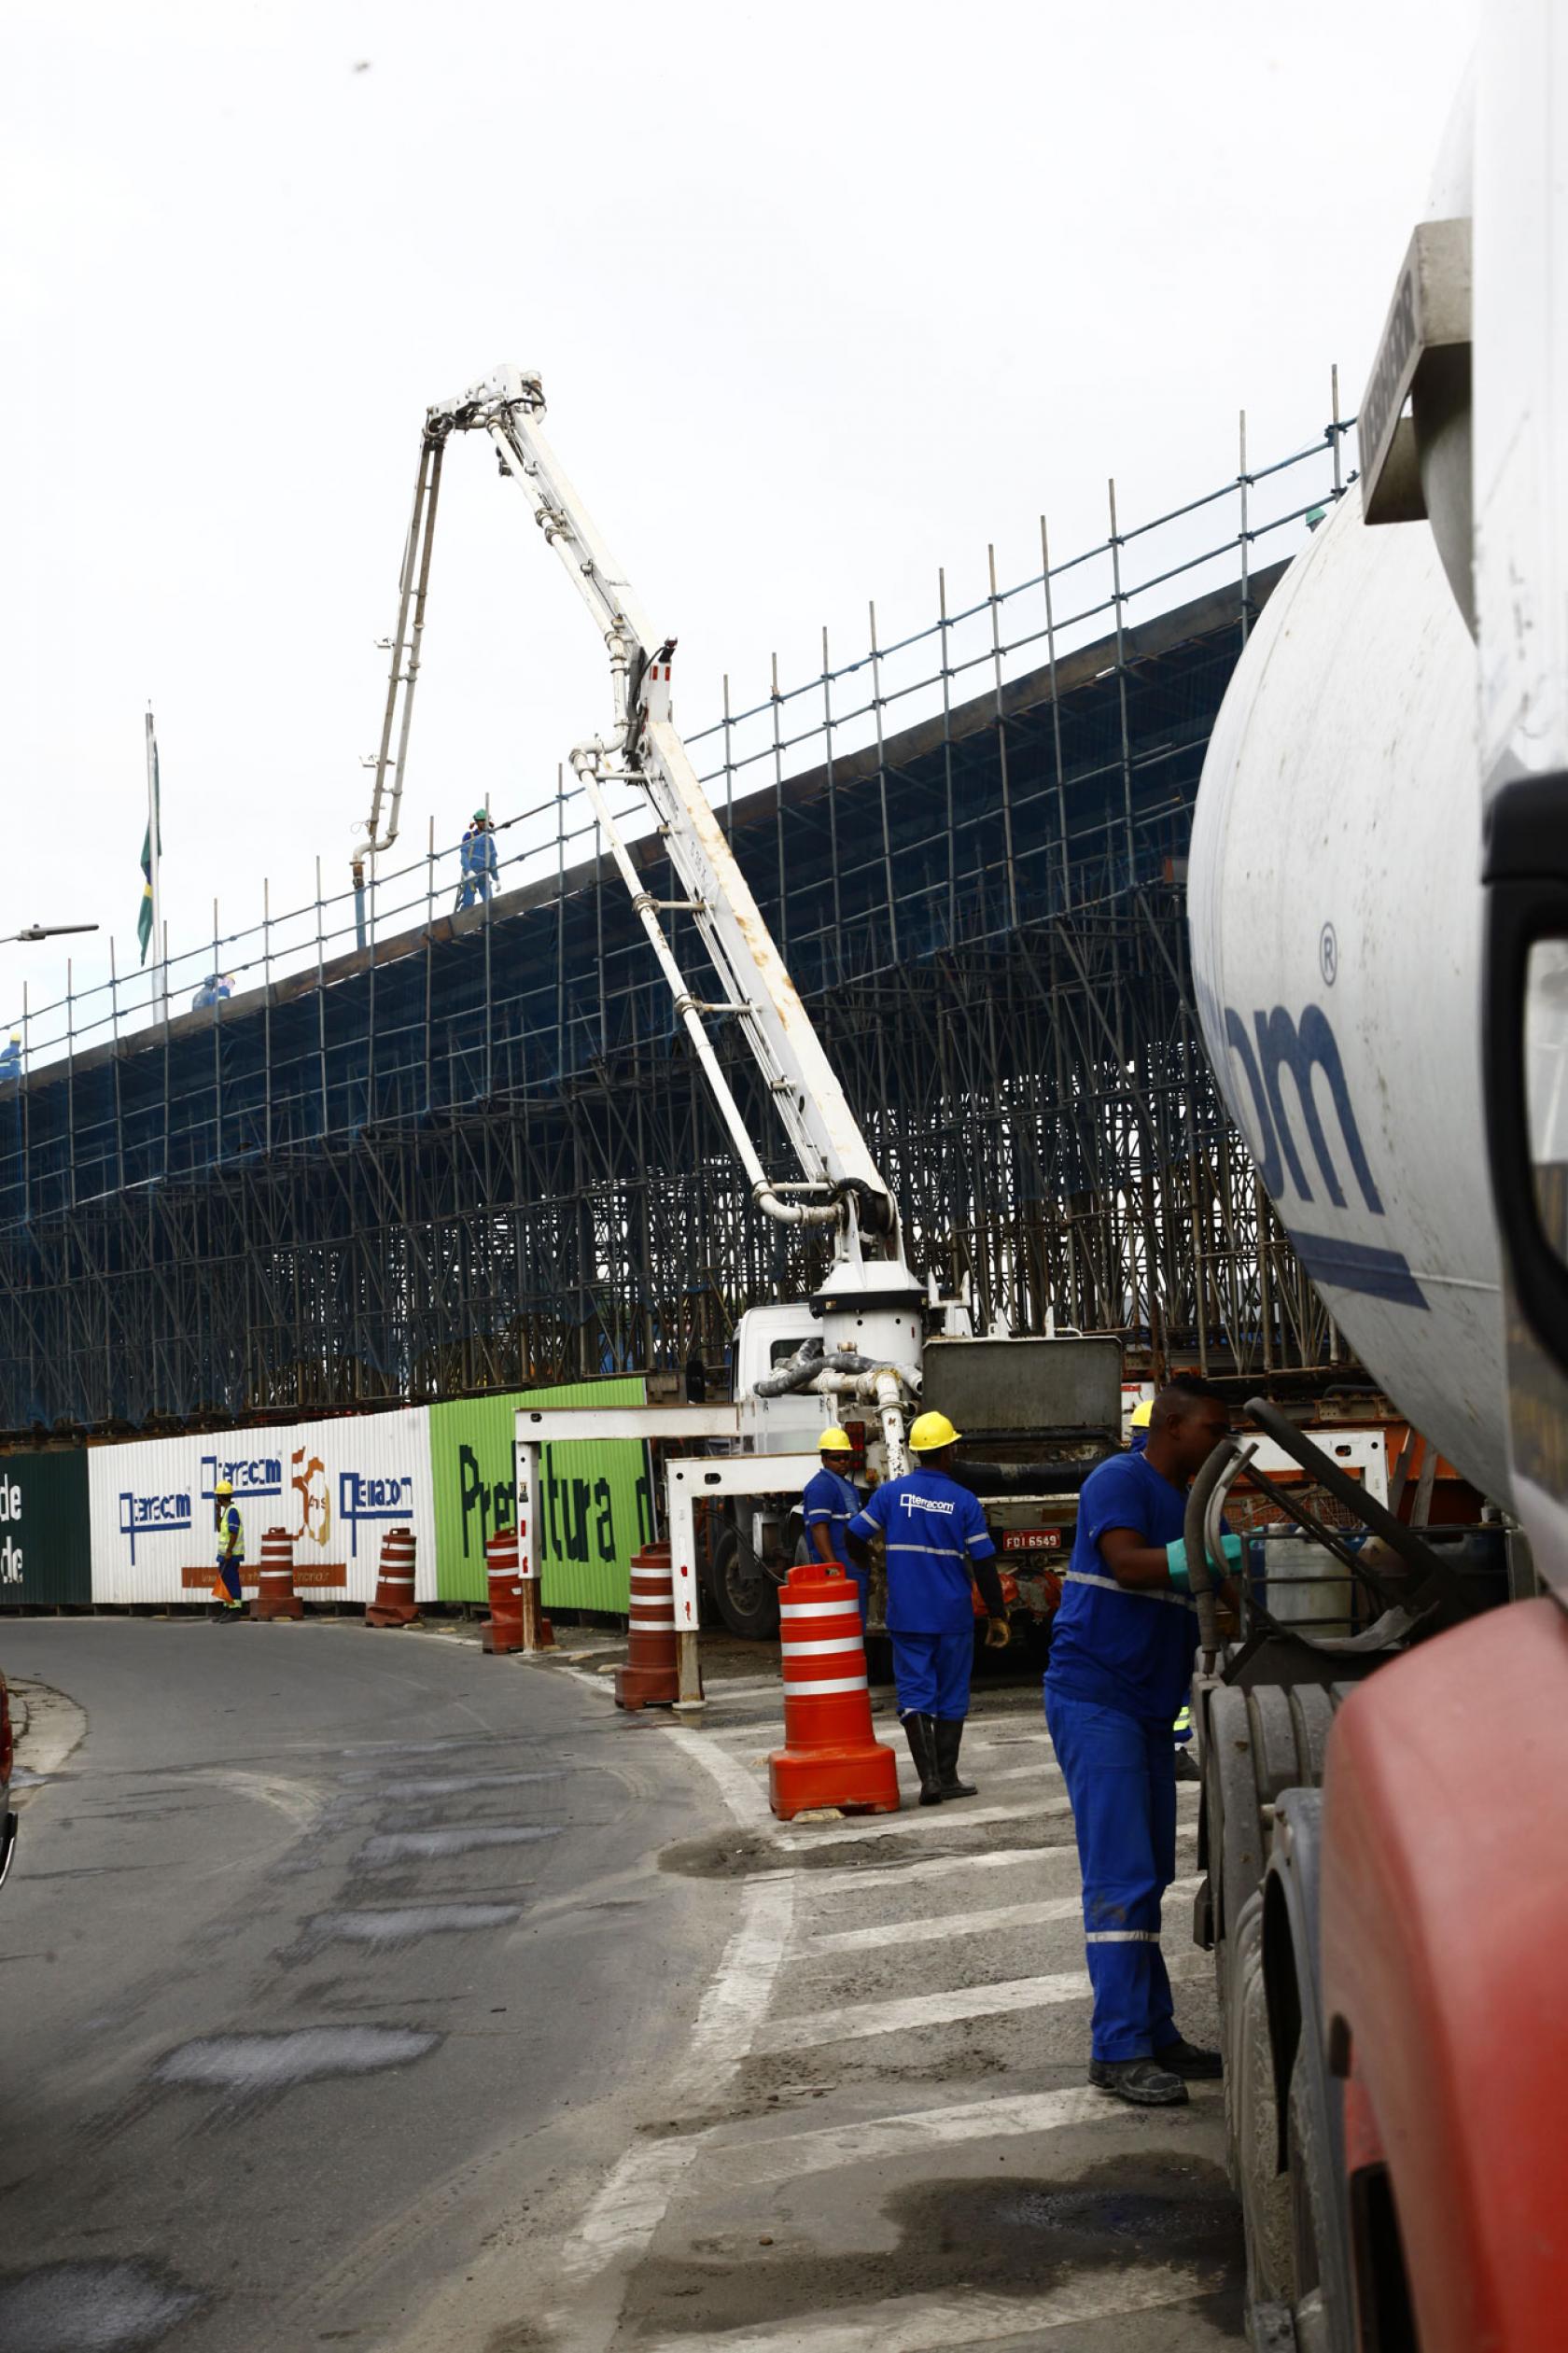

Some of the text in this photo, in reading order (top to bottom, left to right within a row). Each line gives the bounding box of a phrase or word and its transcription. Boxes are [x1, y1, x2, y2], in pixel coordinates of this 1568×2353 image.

[459, 1439, 616, 1562] Prefitura
[912, 1493, 954, 1512] terracom
[1029, 1534, 1057, 1547] 6549
